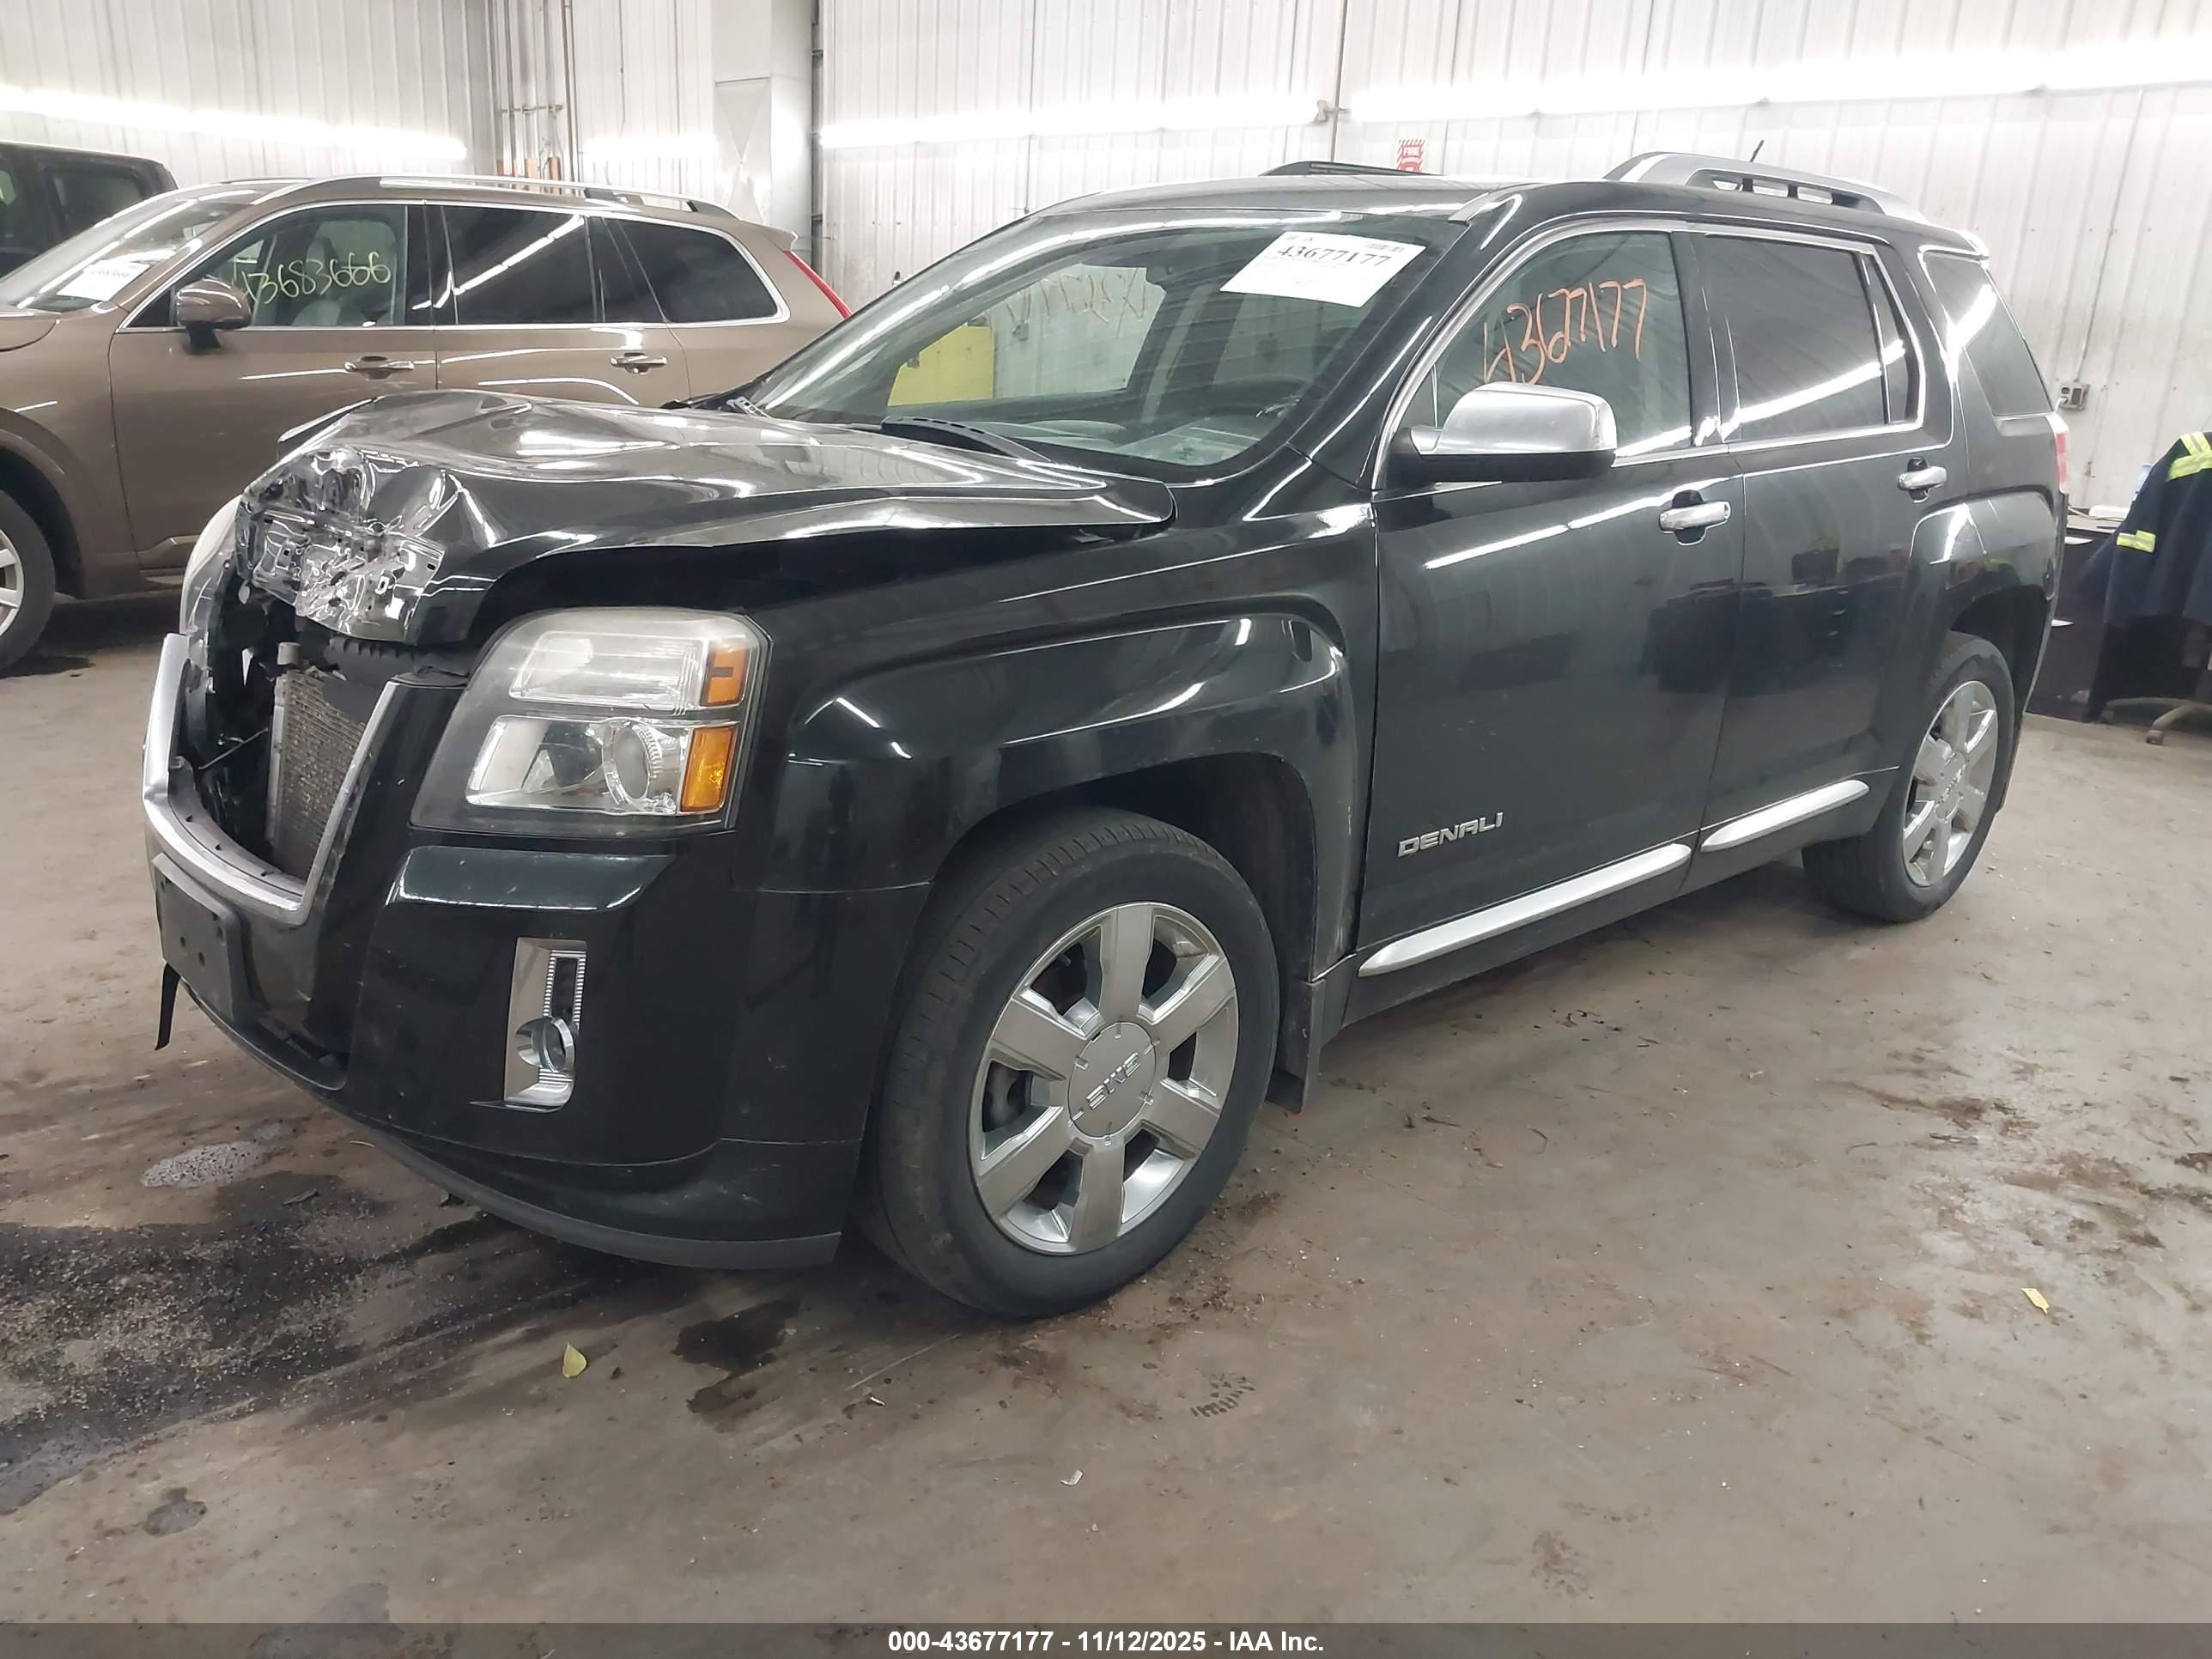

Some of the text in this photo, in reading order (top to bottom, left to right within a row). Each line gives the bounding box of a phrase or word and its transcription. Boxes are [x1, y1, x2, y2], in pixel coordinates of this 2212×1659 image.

[1403, 147, 1420, 156] FIRE
[1277, 245, 1392, 267] 43677177
[1483, 278, 1647, 385] 43677177
[1397, 811, 1504, 857] DENALI
